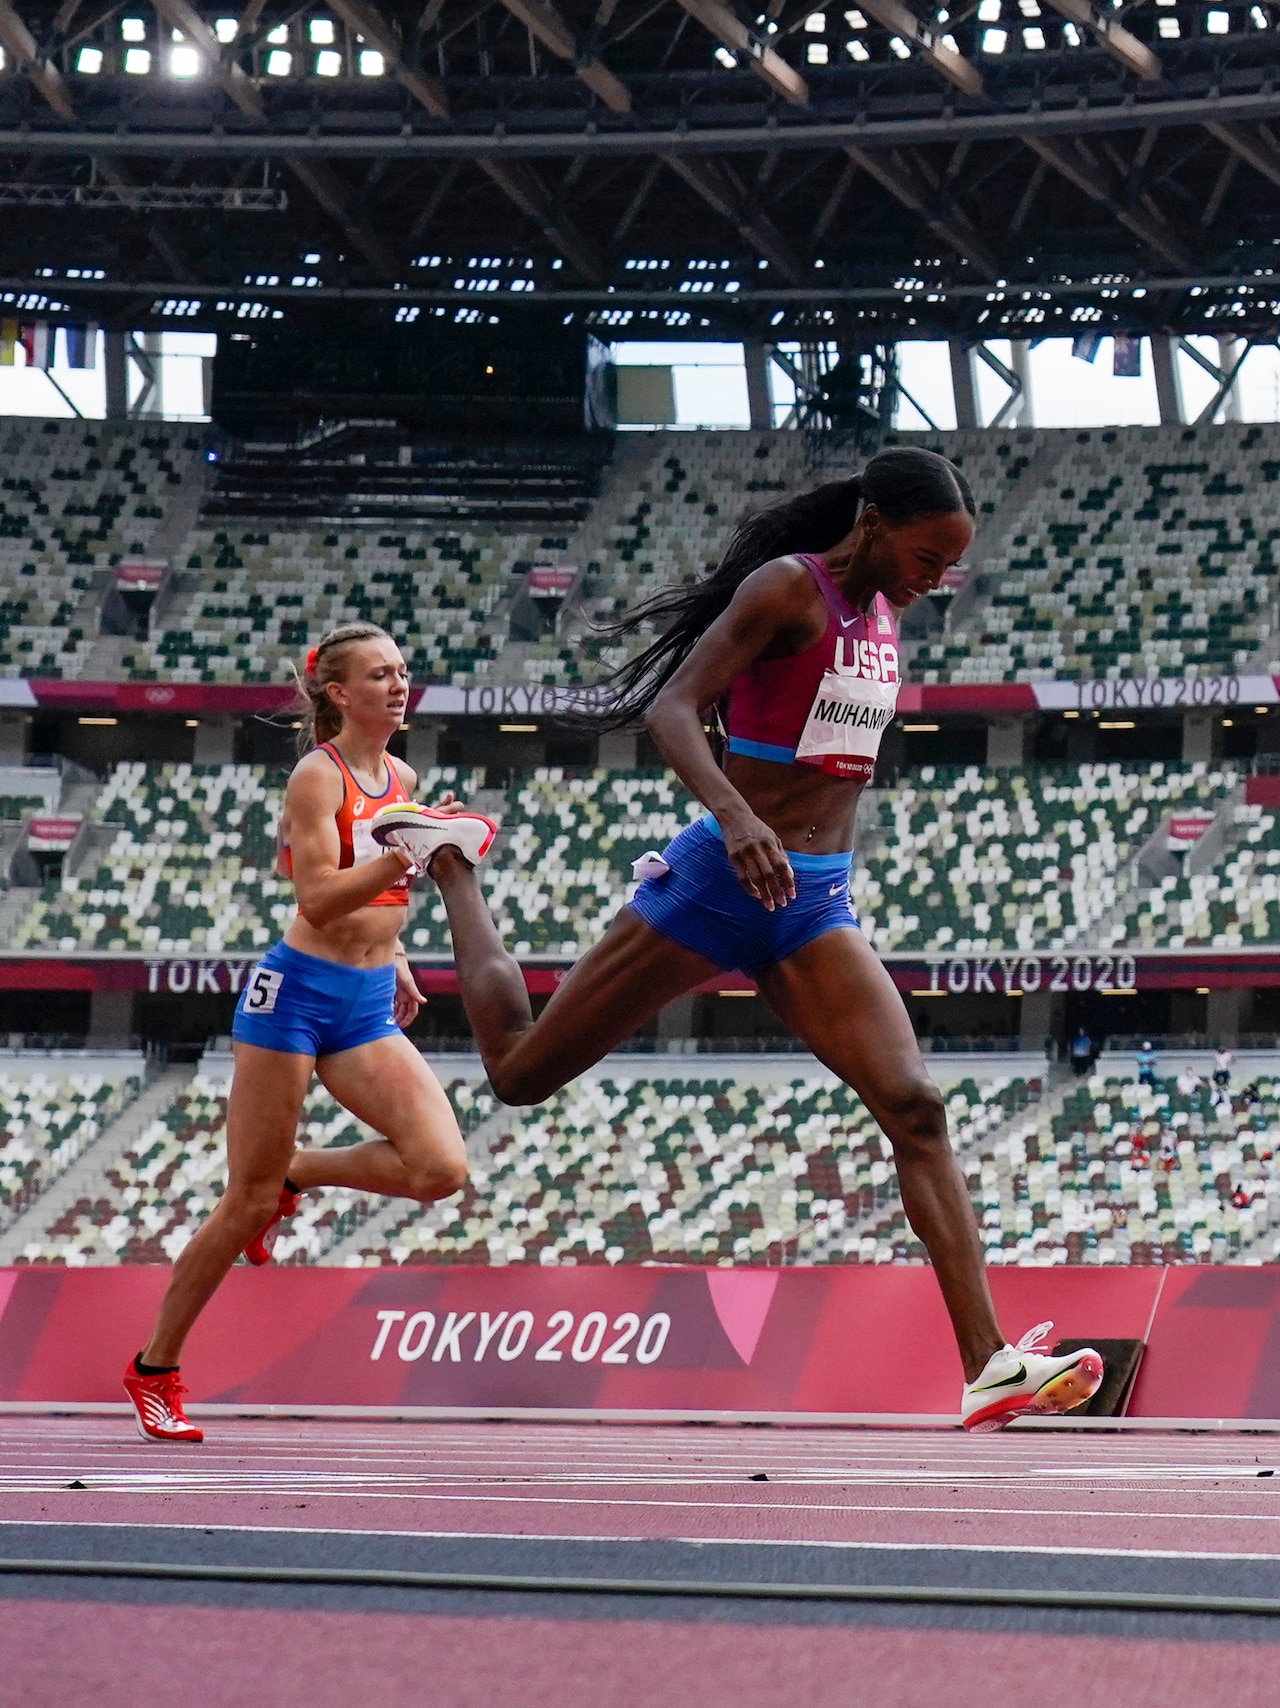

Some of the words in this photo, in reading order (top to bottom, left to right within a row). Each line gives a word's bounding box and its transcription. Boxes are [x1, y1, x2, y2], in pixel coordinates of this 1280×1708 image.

[834, 636, 899, 683] USA
[461, 685, 557, 715] TOKYO
[1074, 678, 1165, 709] TOKYO
[1175, 675, 1240, 705] 2020
[146, 960, 257, 994] TOKY
[249, 972, 272, 1008] 5
[925, 957, 1042, 994] TOKYO
[1050, 955, 1137, 992] 2020
[369, 1309, 535, 1362] TOKYO
[534, 1309, 671, 1365] 2020
